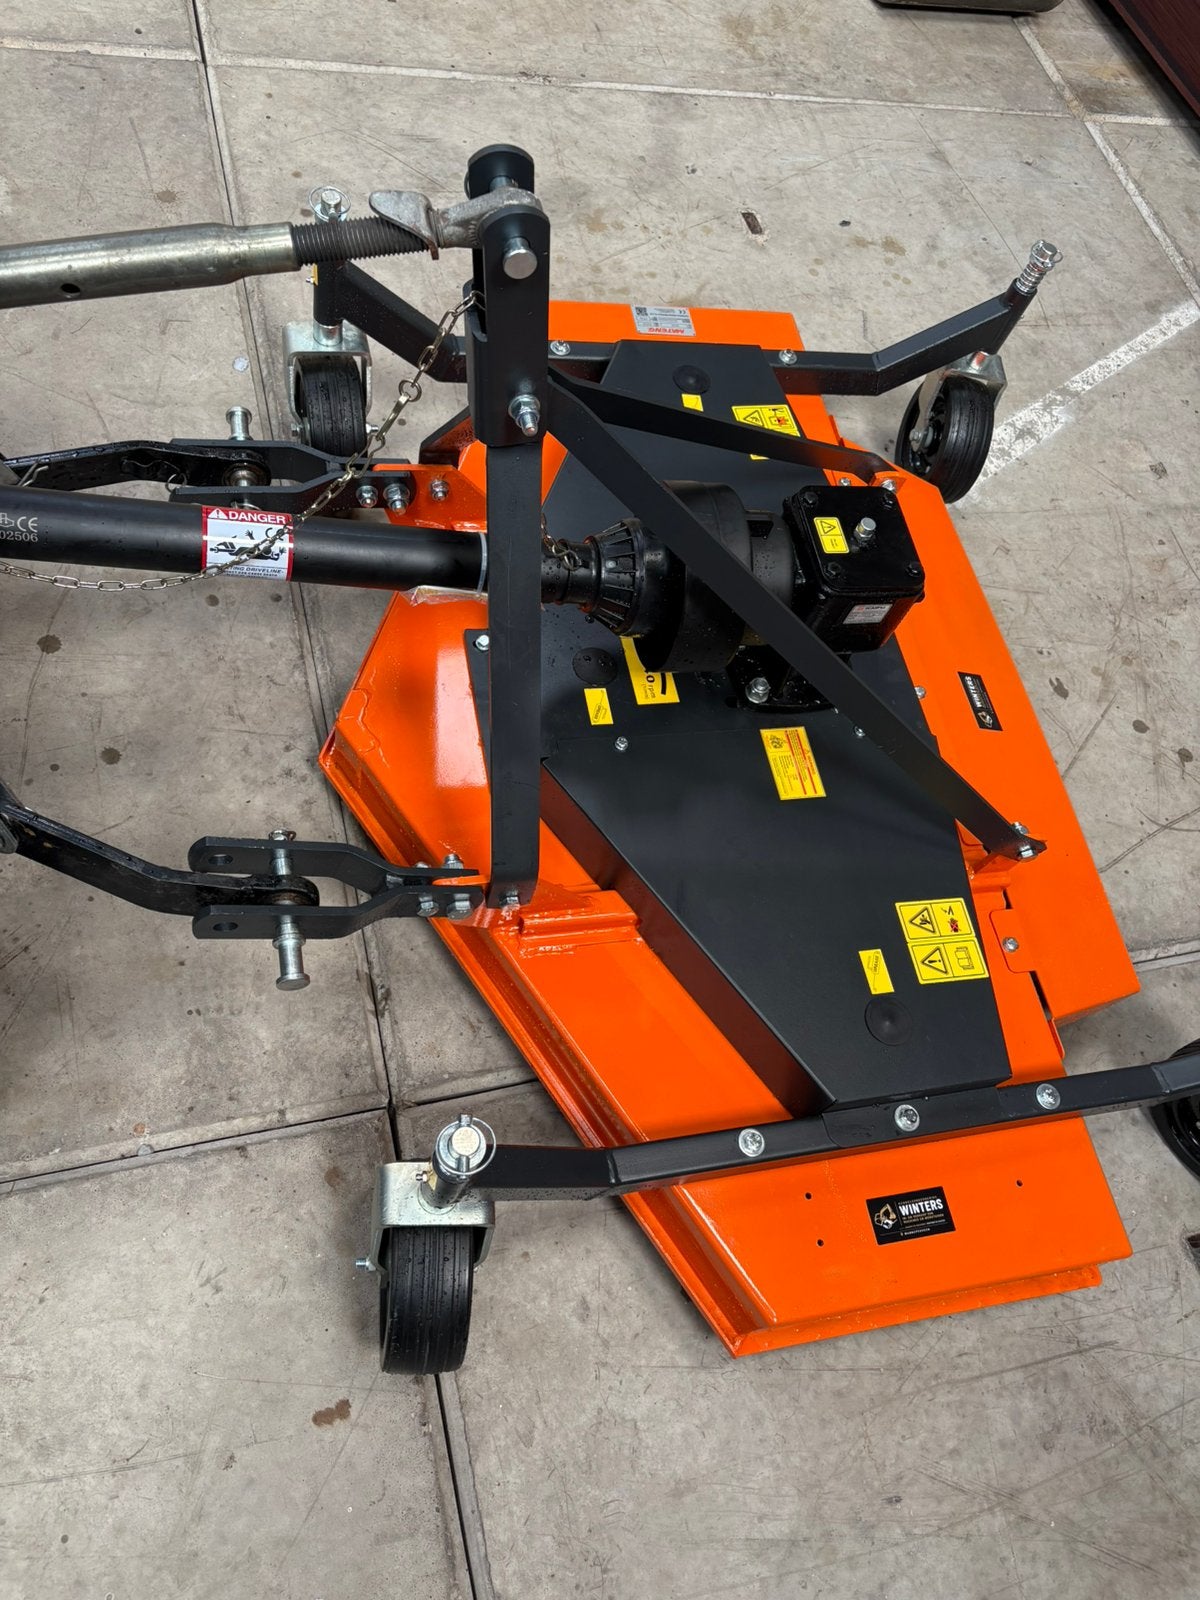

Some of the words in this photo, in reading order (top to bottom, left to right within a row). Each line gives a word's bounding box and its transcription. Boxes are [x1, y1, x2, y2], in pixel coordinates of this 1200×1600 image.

[228, 511, 286, 524] DANGER
[965, 676, 982, 708] WINTERS
[898, 1198, 944, 1217] WINTERS
